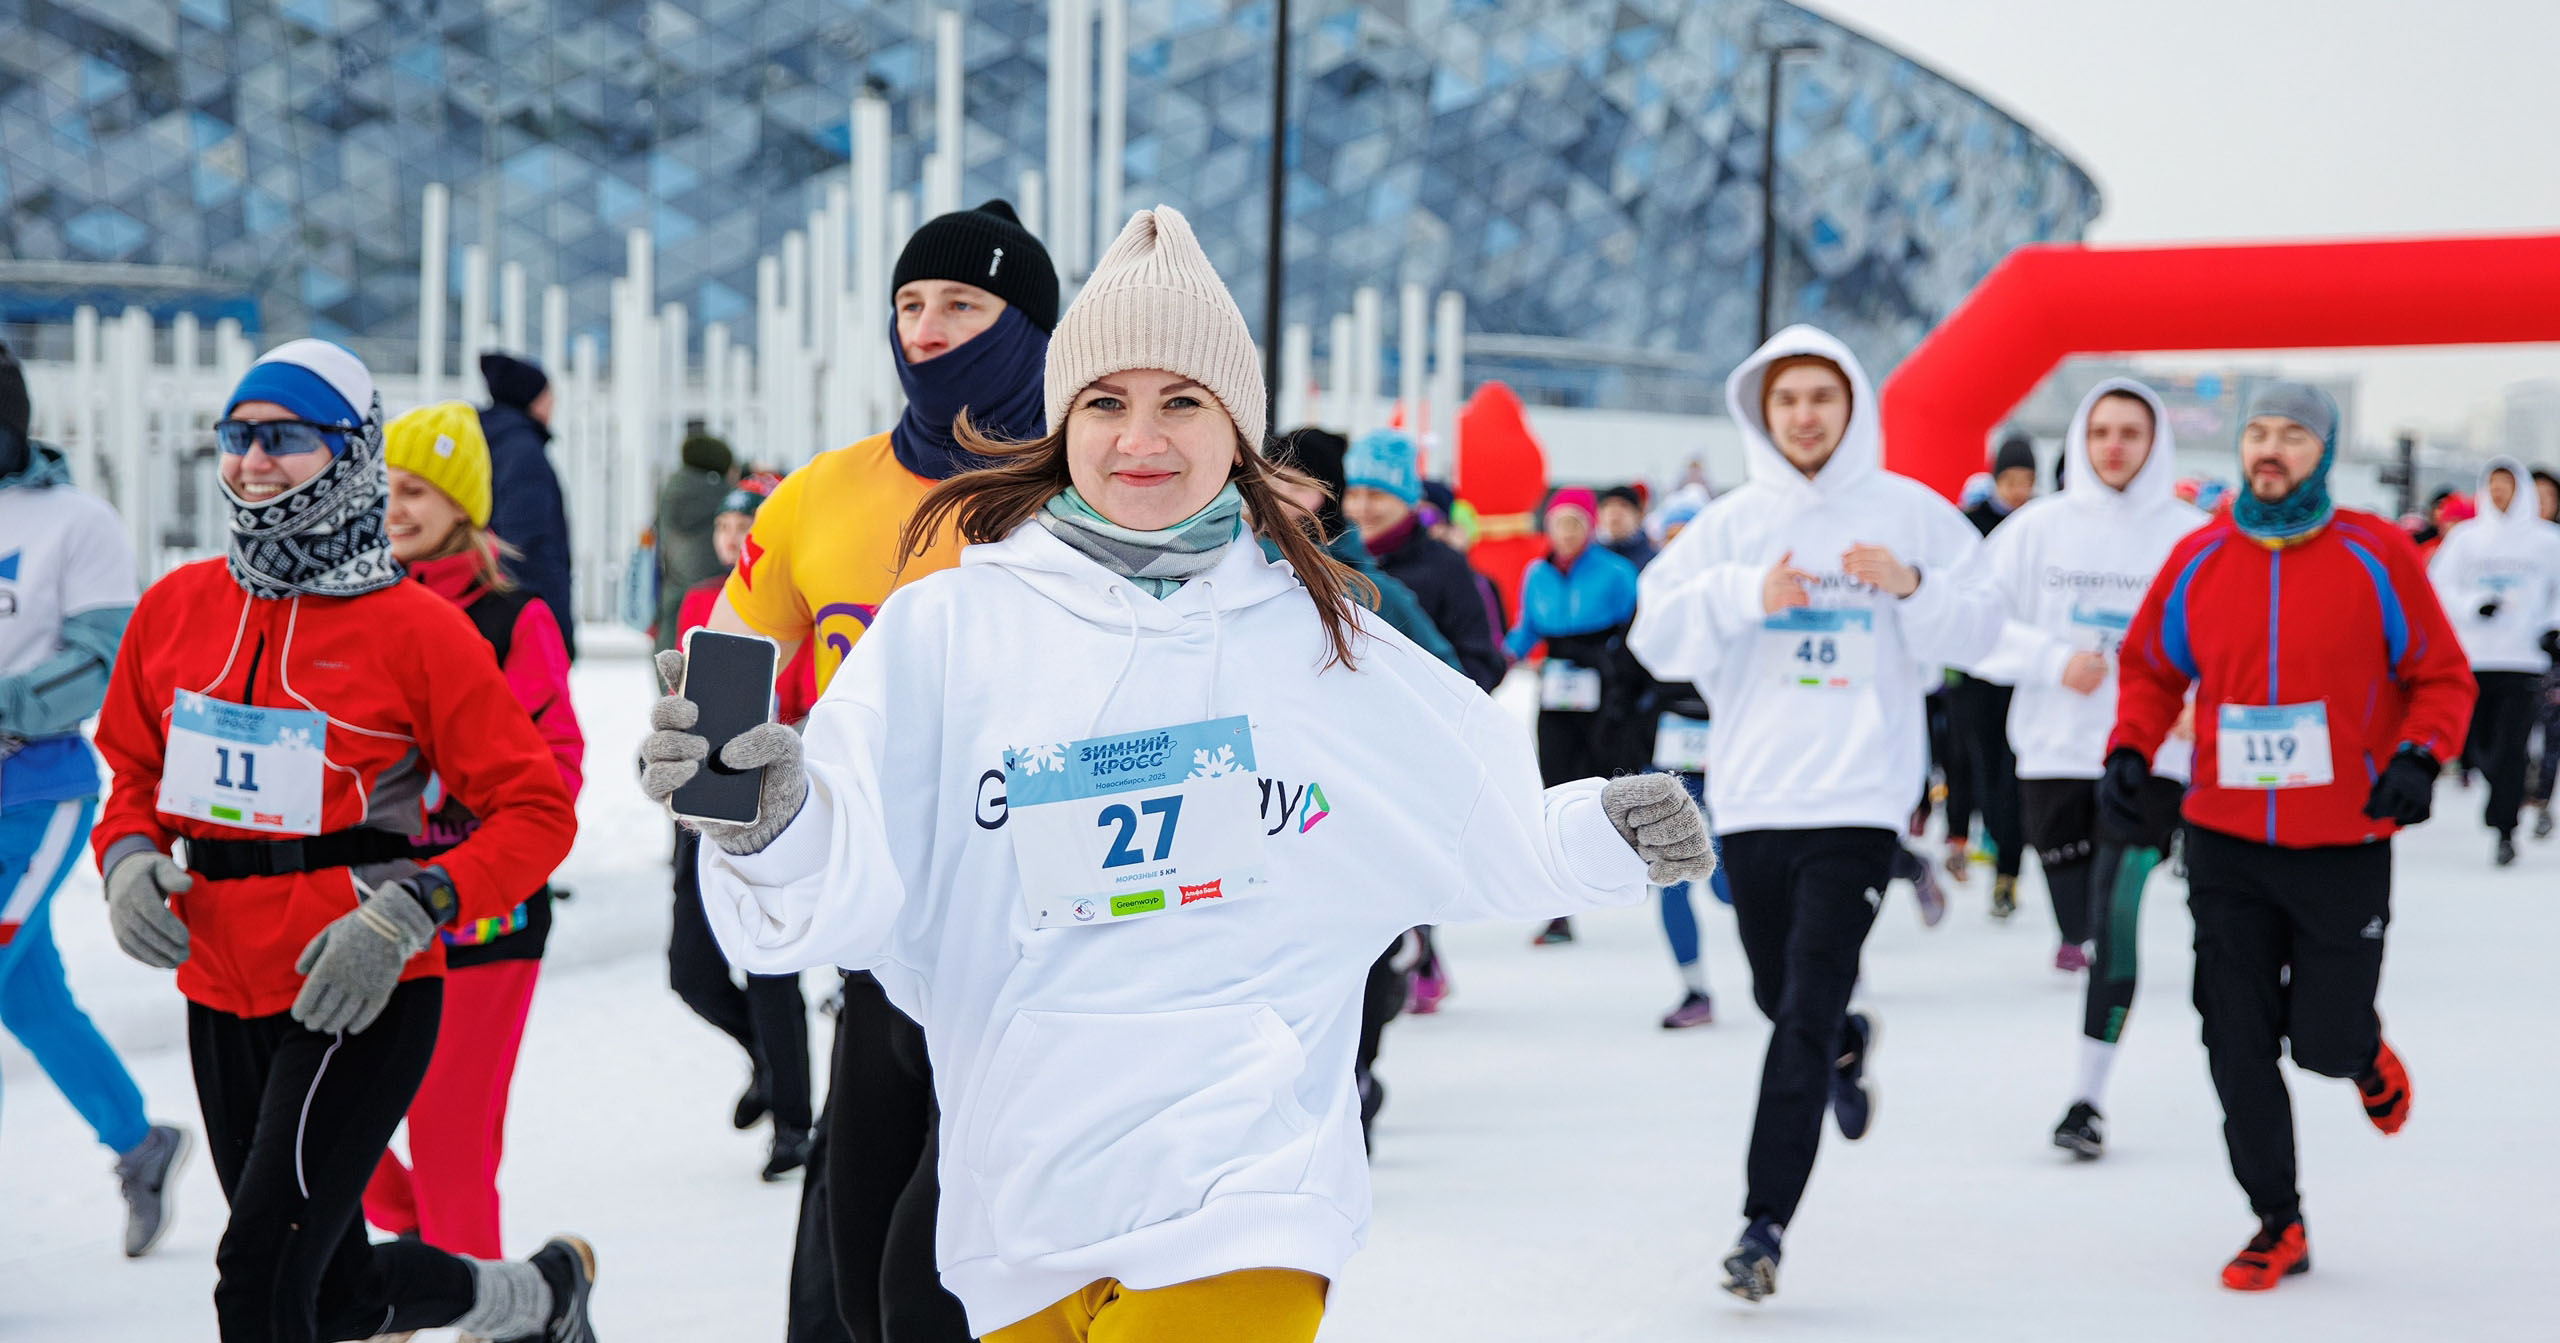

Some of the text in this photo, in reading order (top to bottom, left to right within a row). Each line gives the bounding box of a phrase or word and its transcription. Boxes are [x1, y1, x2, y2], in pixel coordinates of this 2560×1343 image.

[1796, 639, 1836, 664] 48
[1080, 731, 1169, 762] ЗИМНИЙ
[2245, 736, 2297, 762] 119
[215, 748, 258, 791] 11
[1091, 752, 1165, 776] КРОСС
[1148, 772, 1167, 782] 2025
[1097, 795, 1184, 869] 27
[1115, 871, 1159, 884] МОРОЗНЫЕ
[1165, 868, 1177, 876] КМ
[1116, 897, 1155, 909] Greenway
